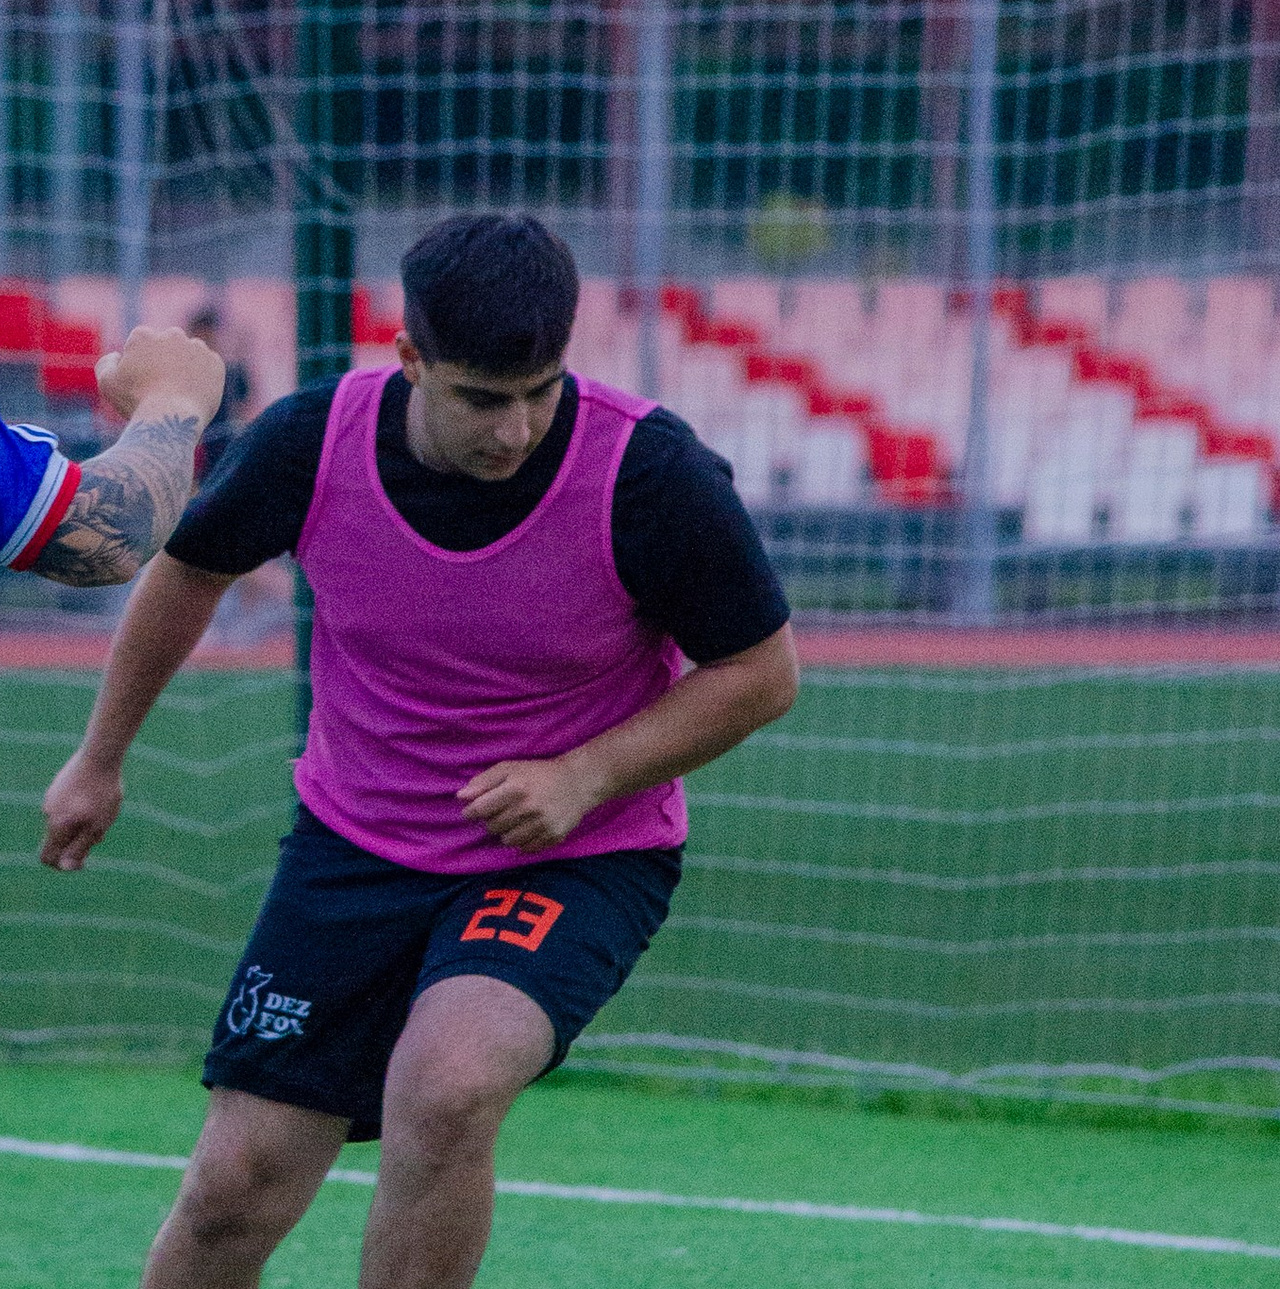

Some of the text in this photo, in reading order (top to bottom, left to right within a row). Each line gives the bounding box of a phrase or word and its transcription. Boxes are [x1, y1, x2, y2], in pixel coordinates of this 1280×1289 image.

[460, 889, 564, 952] 23
[264, 992, 312, 1018] DEZ
[261, 1011, 304, 1035] FOX
